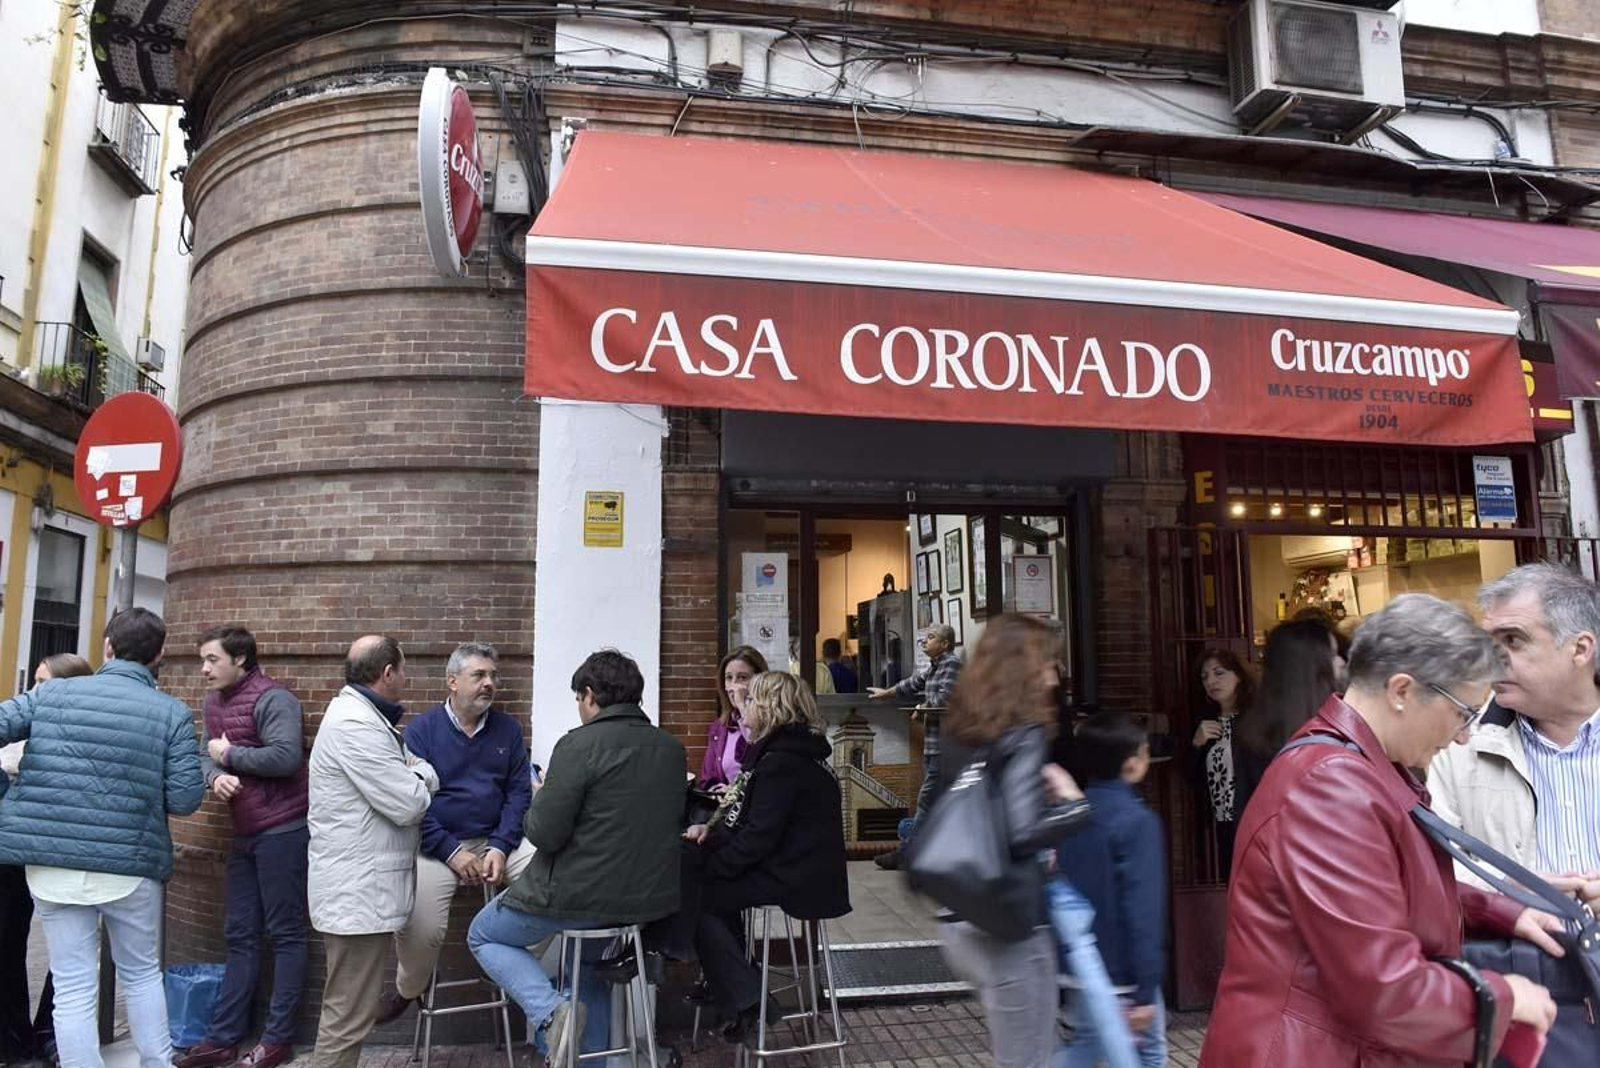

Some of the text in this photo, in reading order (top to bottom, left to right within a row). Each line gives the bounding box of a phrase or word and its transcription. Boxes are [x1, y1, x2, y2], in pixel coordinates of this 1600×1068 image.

[591, 307, 1211, 402] CASA CORONADO
[1271, 328, 1471, 386] Cruzcampo
[1268, 383, 1474, 407] MAESTROS CERVECEROS
[1358, 414, 1399, 430] 1904
[1476, 464, 1499, 473] tyco
